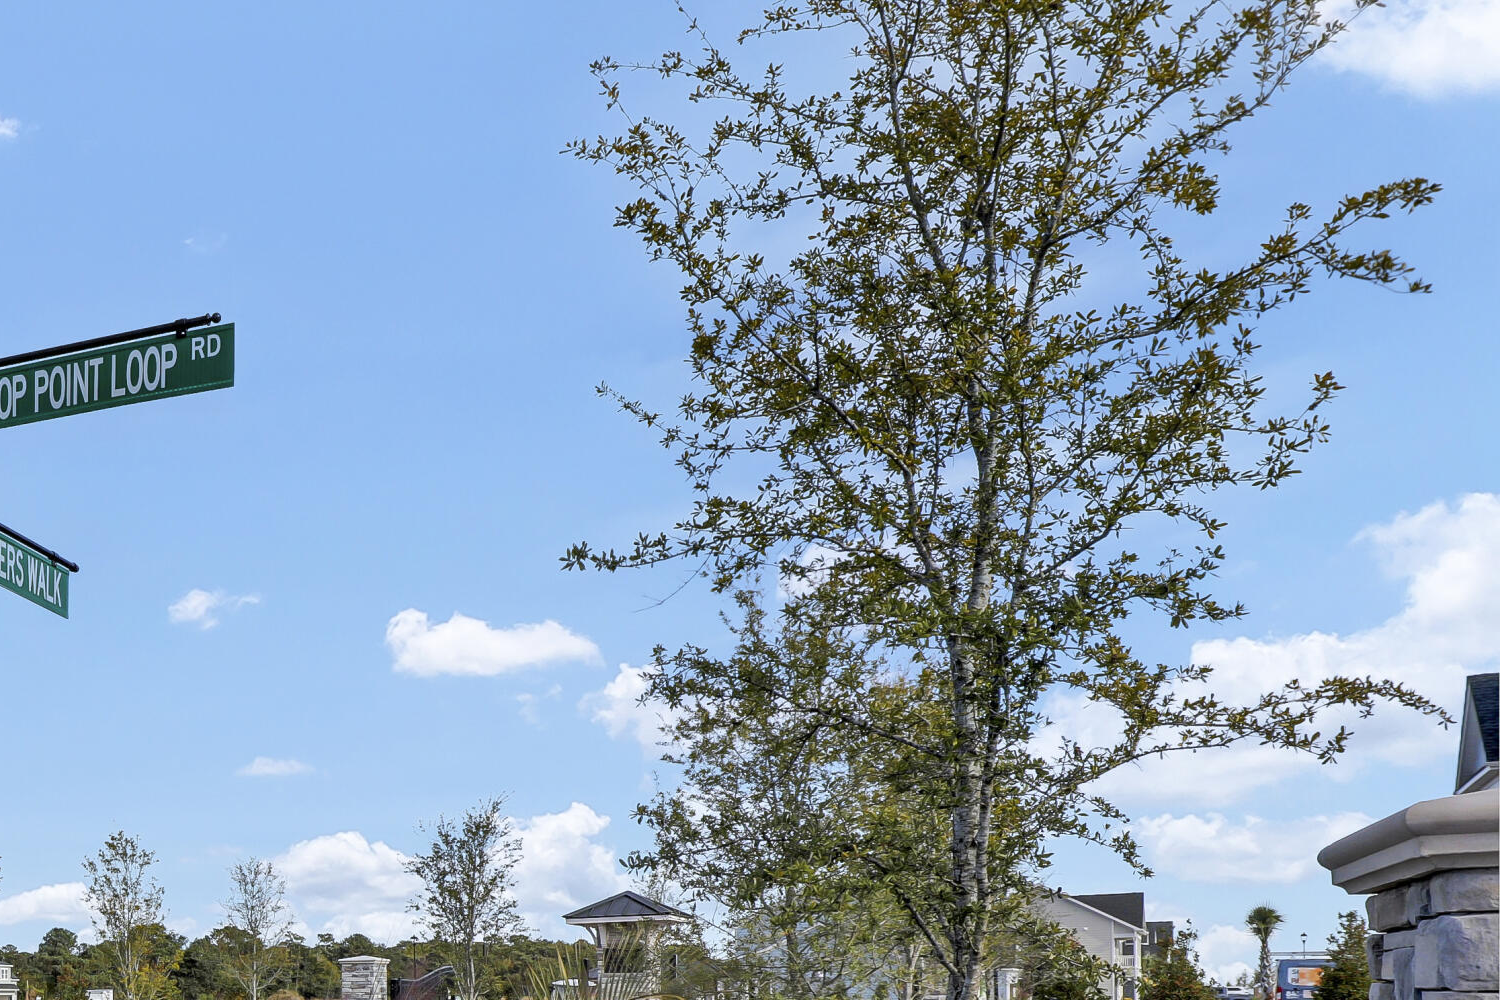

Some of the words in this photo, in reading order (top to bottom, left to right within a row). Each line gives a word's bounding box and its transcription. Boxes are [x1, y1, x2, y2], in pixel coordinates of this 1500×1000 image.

[34, 357, 104, 413] POINT
[111, 342, 178, 398] LOOP
[190, 333, 222, 361] RD
[27, 554, 63, 608] WALK
